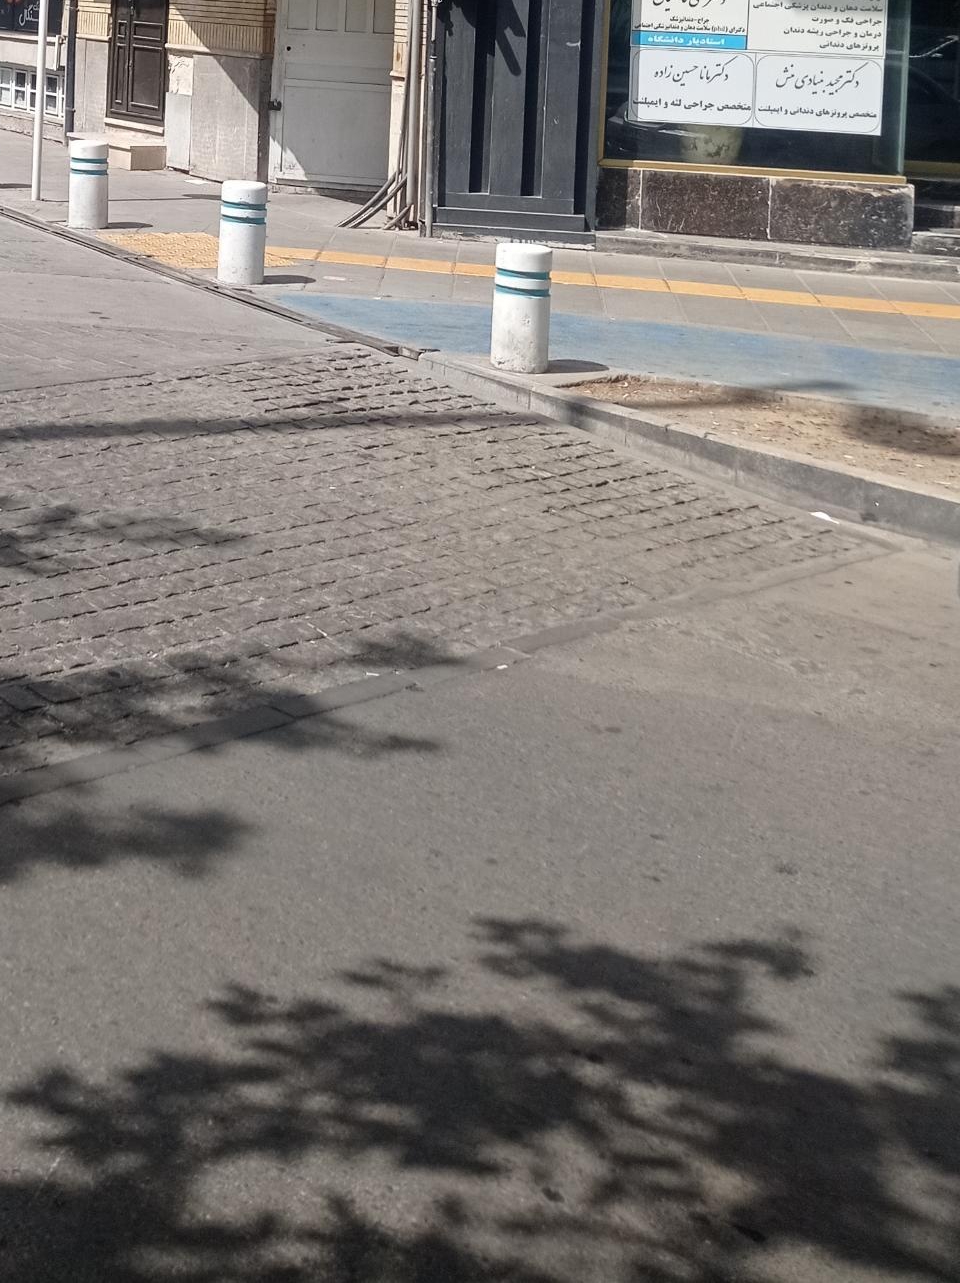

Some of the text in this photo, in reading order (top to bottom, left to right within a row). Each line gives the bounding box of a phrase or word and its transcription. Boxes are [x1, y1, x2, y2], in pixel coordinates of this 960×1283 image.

[752, 1, 783, 9] اجتماعی
[784, 2, 809, 11] پزشکی
[810, 3, 832, 11] دندان
[839, 4, 858, 12] دهان
[855, 18, 882, 26] جراحی
[806, 27, 824, 36] ریشه
[825, 29, 852, 37] جراحی
[859, 31, 882, 39] درمان
[647, 35, 725, 46] استادیار دانشگاه
[819, 40, 845, 49] دندانی
[653, 64, 674, 79] زاده
[707, 55, 739, 84] دکتر
[672, 65, 699, 87] حسین
[775, 61, 869, 96] دکتر مجید بنیادی منش
[663, 101, 669, 109] و
[670, 98, 682, 107] لثه
[683, 100, 714, 111] جراحی
[716, 102, 752, 111] متخصص
[789, 107, 814, 115] دندانی
[848, 110, 877, 118] متخصص
